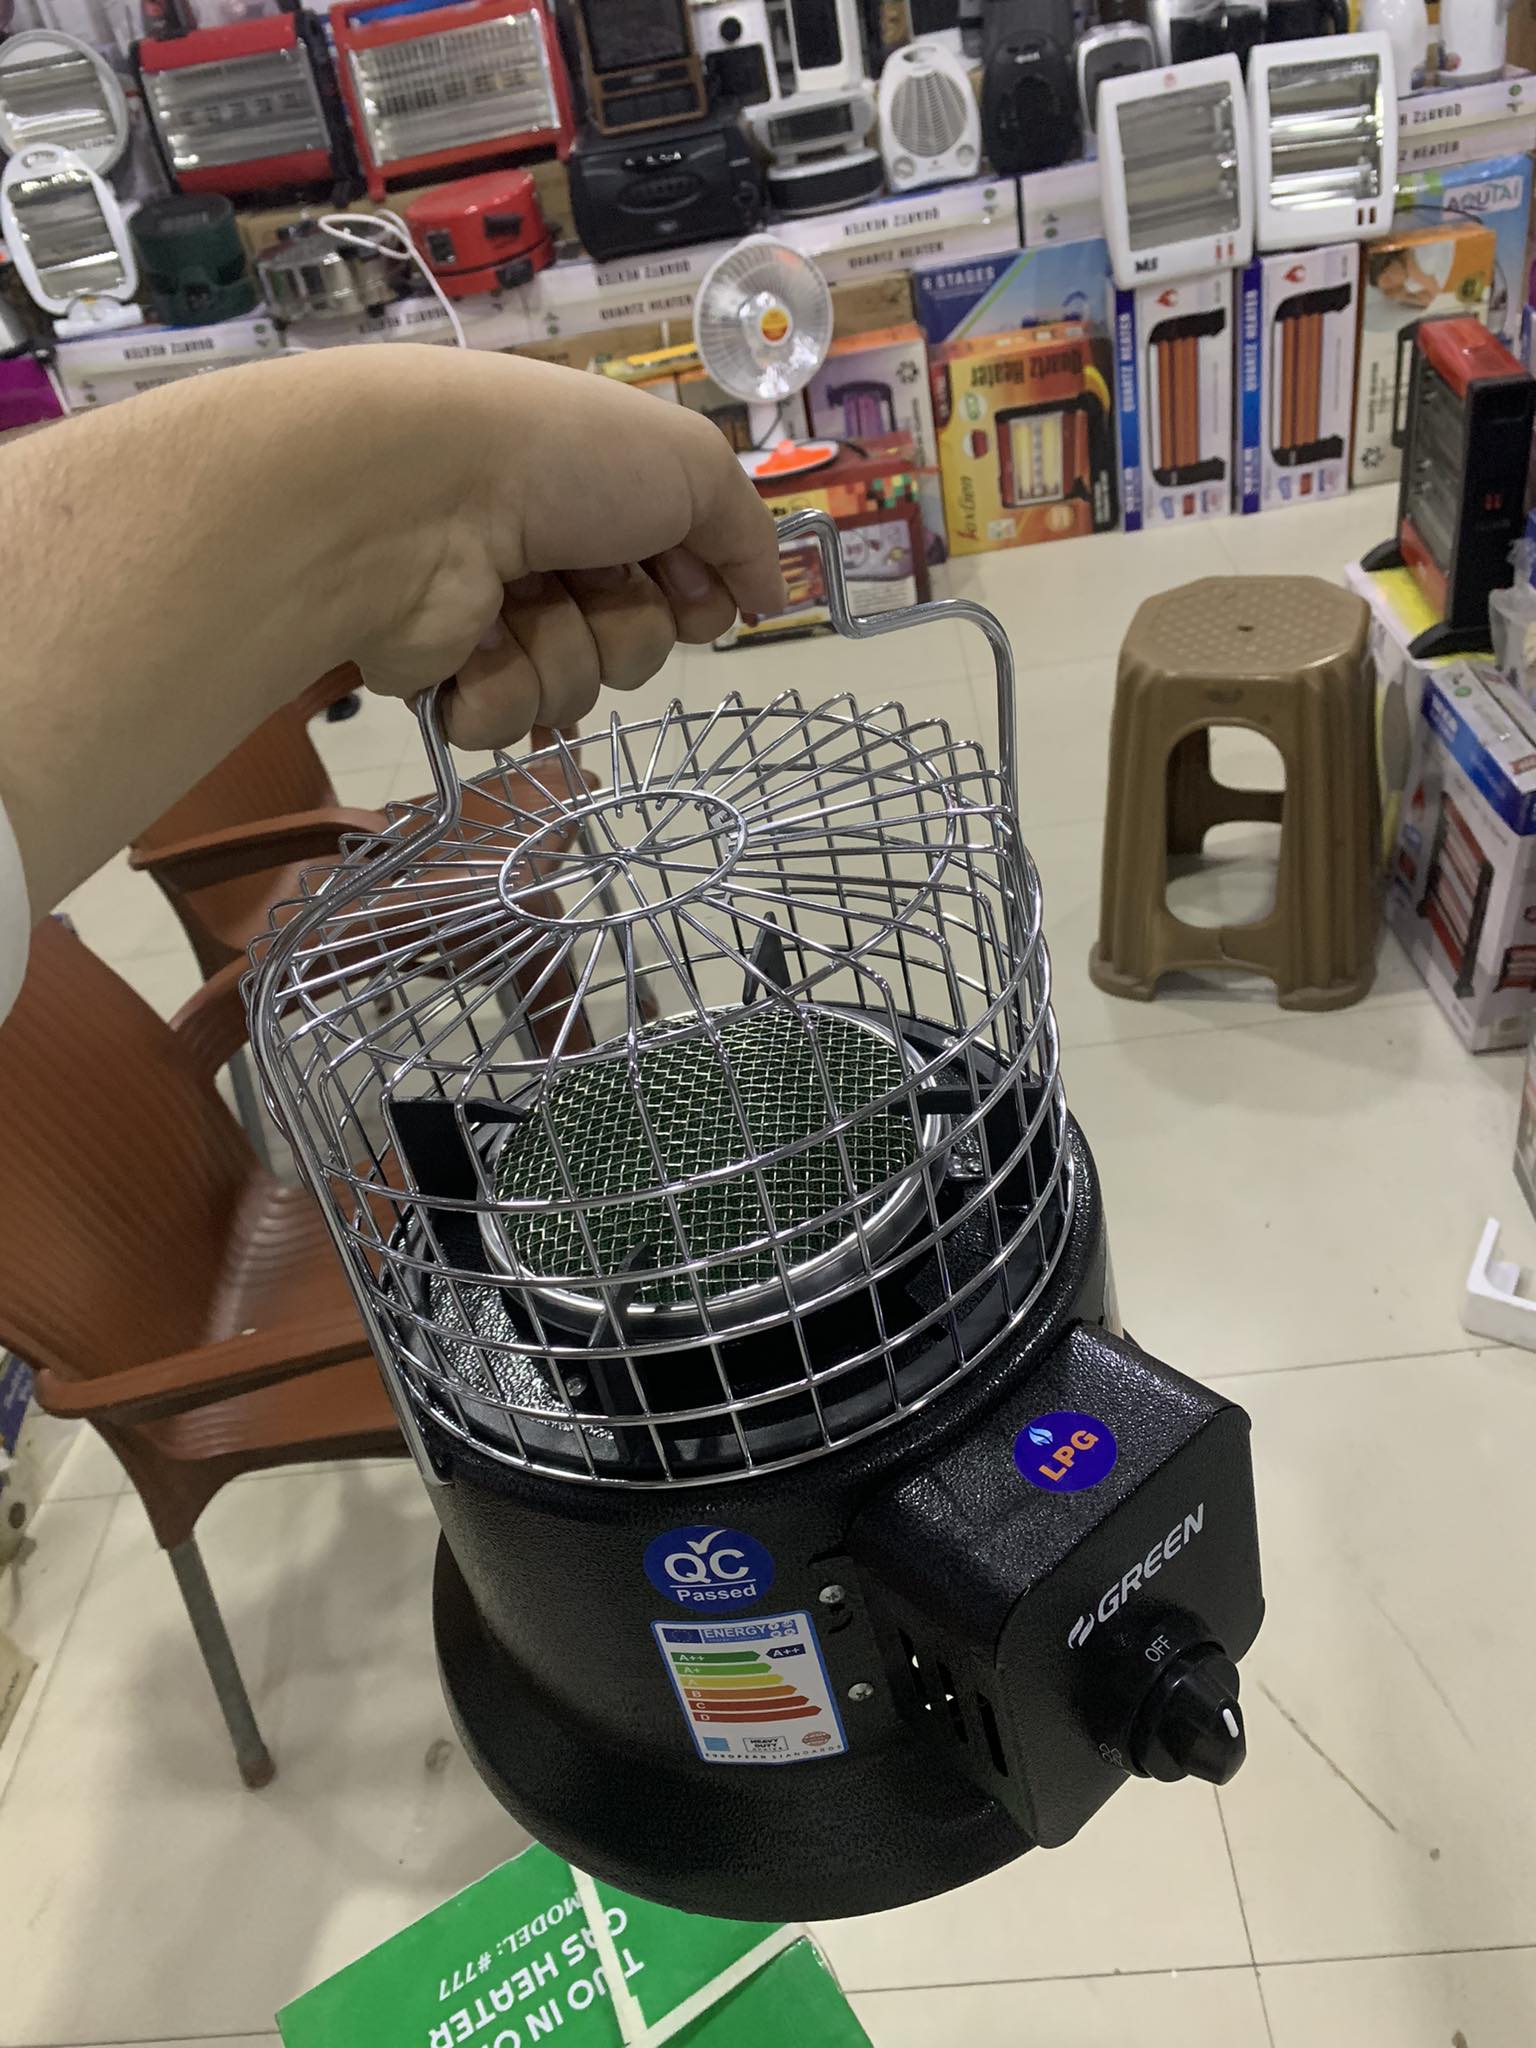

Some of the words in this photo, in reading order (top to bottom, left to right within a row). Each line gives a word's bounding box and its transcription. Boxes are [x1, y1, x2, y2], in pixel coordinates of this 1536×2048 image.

[1039, 1430, 1099, 1482] LPG
[664, 1549, 749, 1583] QC
[1098, 1503, 1204, 1622] GREEN
[677, 1584, 756, 1602] Passed
[705, 1625, 765, 1639] ENERGY
[1145, 1635, 1170, 1662] OFF
[679, 1654, 704, 1662] A++
[773, 1647, 800, 1657] A++
[496, 1891, 583, 1955] MODEL:
[439, 1952, 491, 2001] #777
[428, 1952, 559, 2048] HEATER
[525, 1998, 564, 2042] IN
